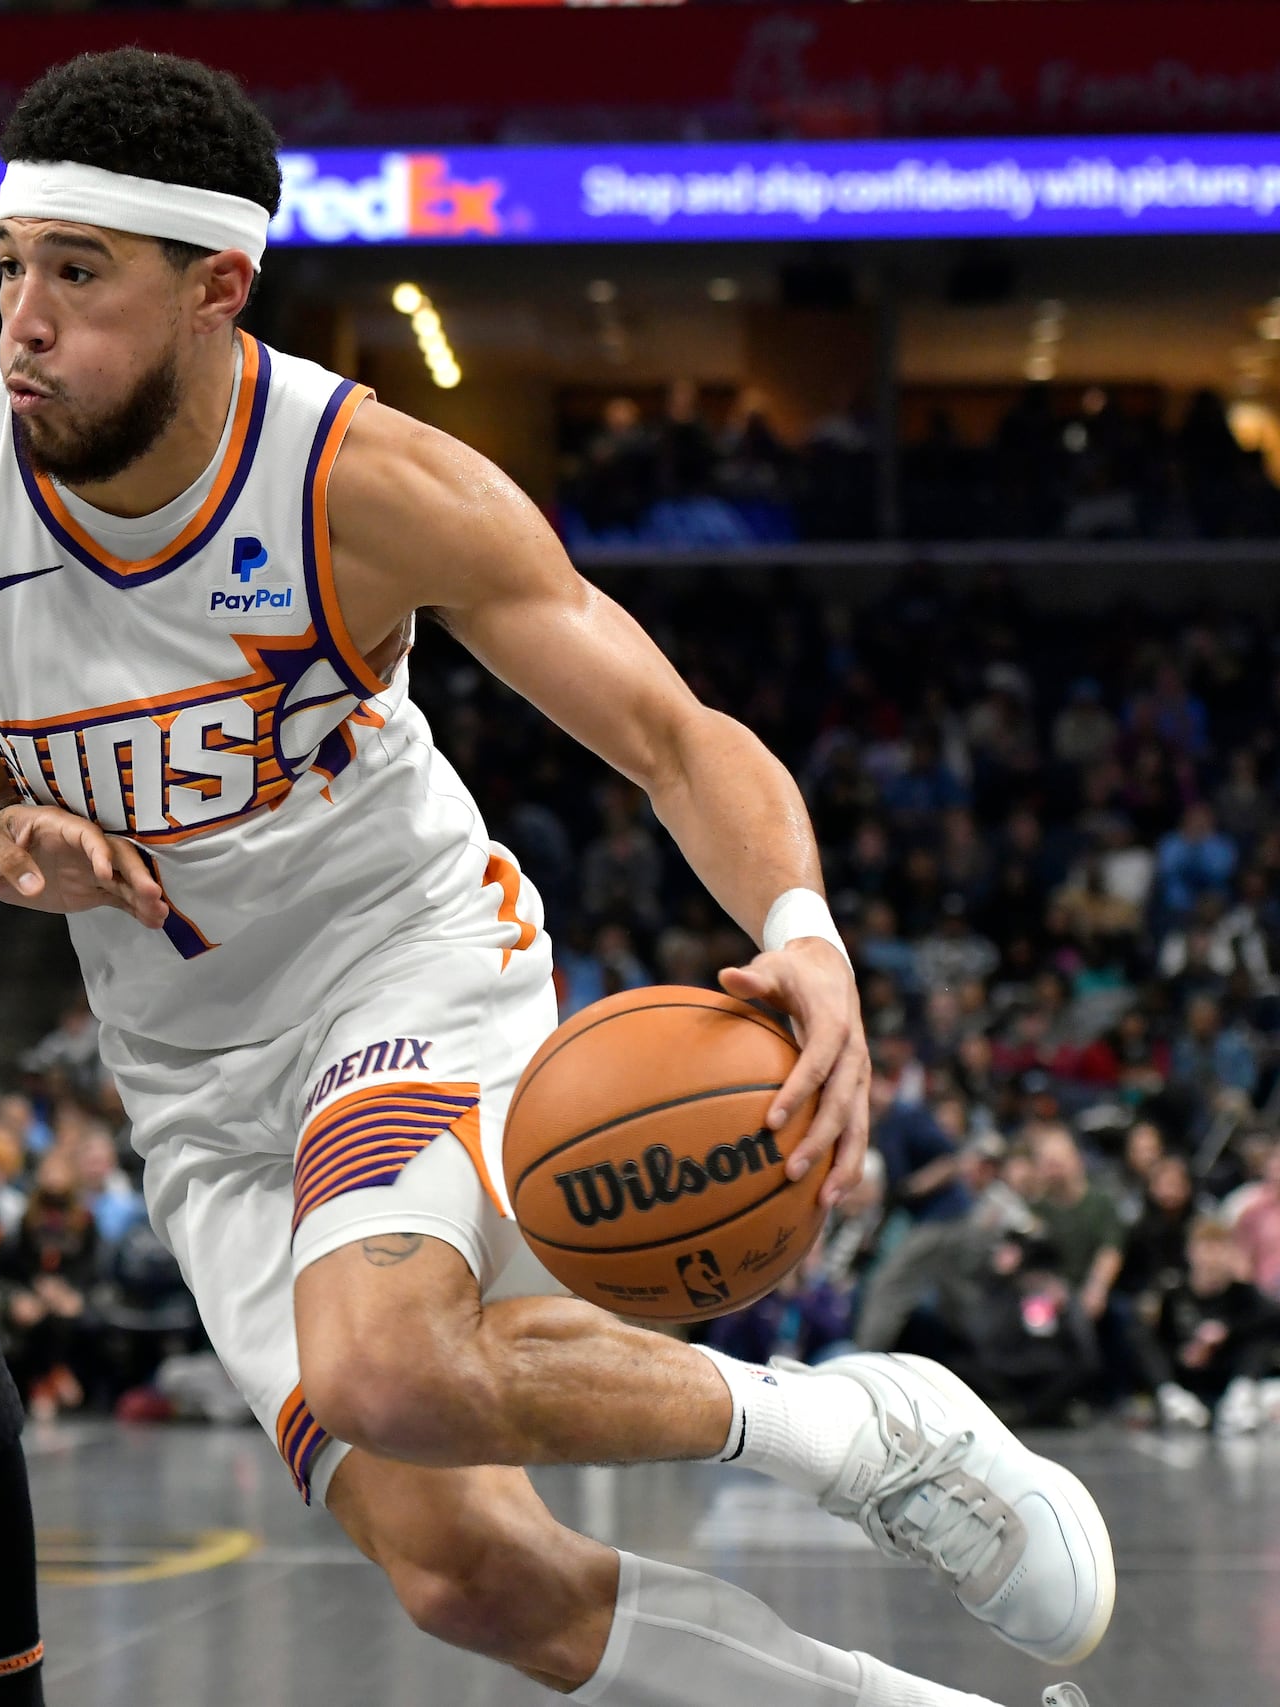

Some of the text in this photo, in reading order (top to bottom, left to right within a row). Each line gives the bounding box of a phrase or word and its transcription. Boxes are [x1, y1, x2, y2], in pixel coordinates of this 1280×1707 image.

[267, 151, 501, 242] FedEx
[210, 588, 292, 613] PayPal
[301, 1038, 433, 1121] HOENIX
[553, 1127, 783, 1227] Wilson
